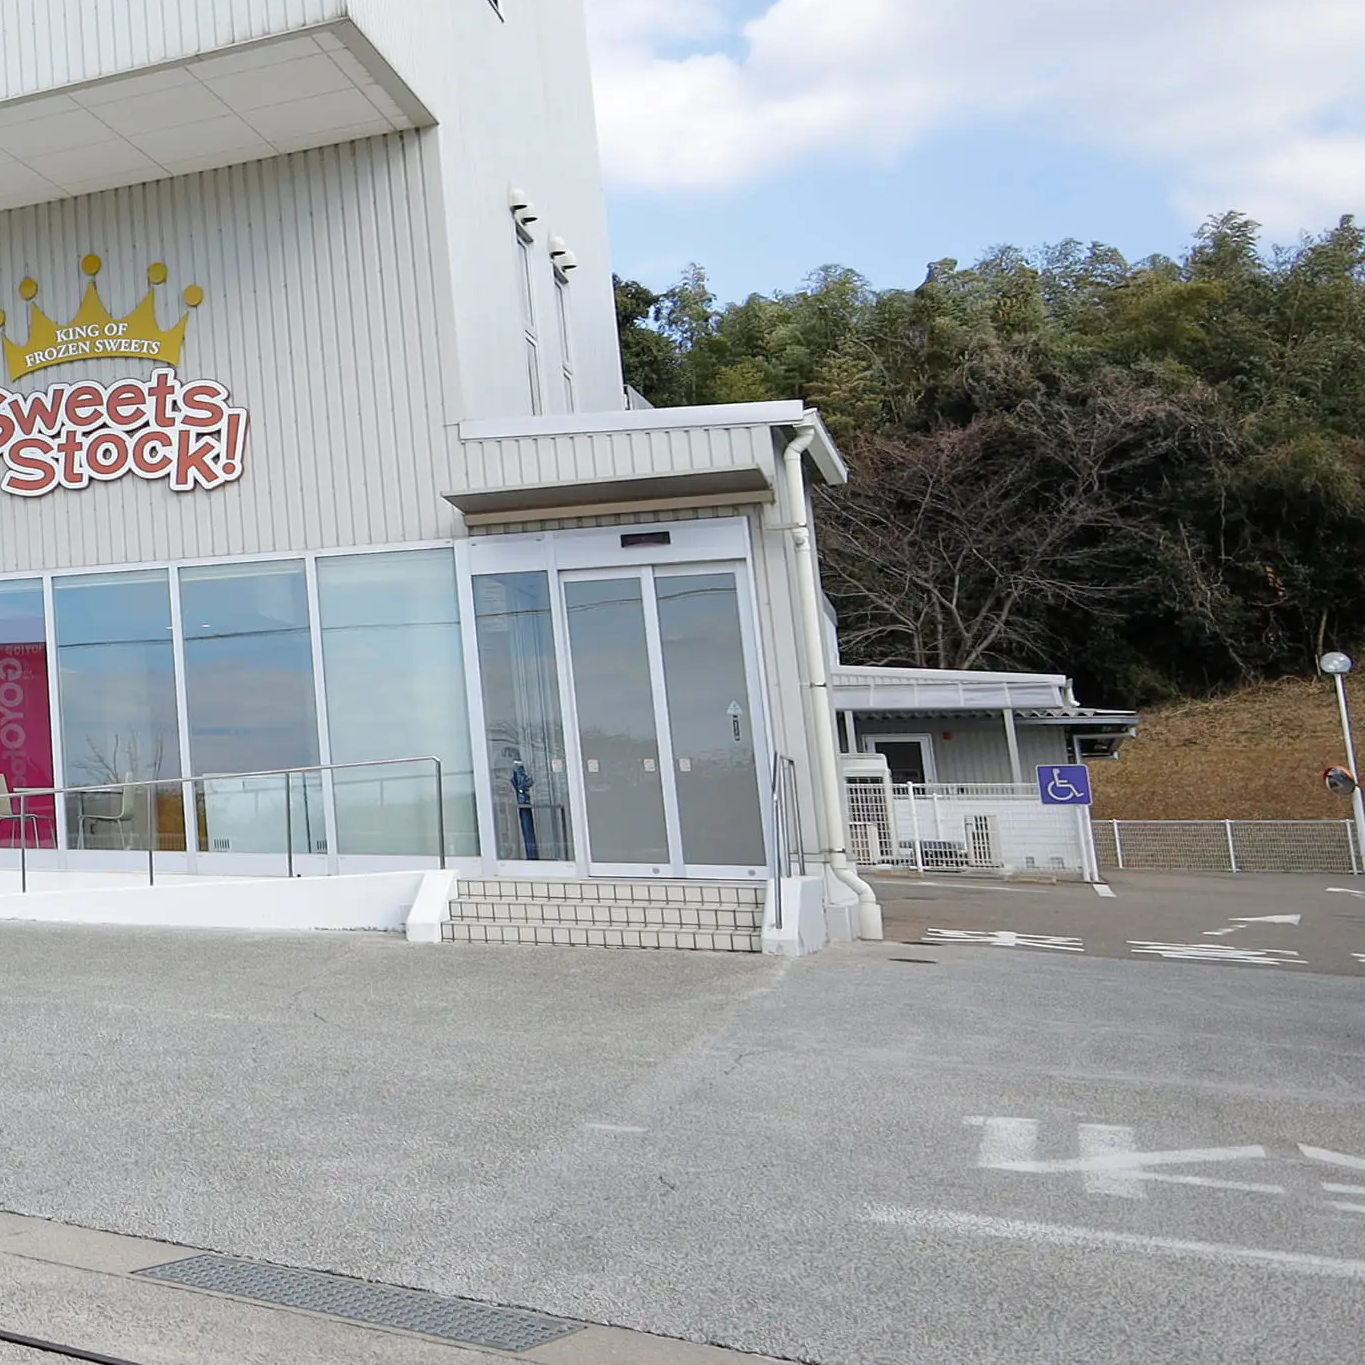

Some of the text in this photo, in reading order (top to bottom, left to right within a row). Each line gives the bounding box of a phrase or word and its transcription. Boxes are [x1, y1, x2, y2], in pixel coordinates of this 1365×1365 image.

[56, 322, 129, 342] KING OF
[24, 337, 161, 368] FROZEN SWEETS
[5, 412, 242, 492] Stock!
